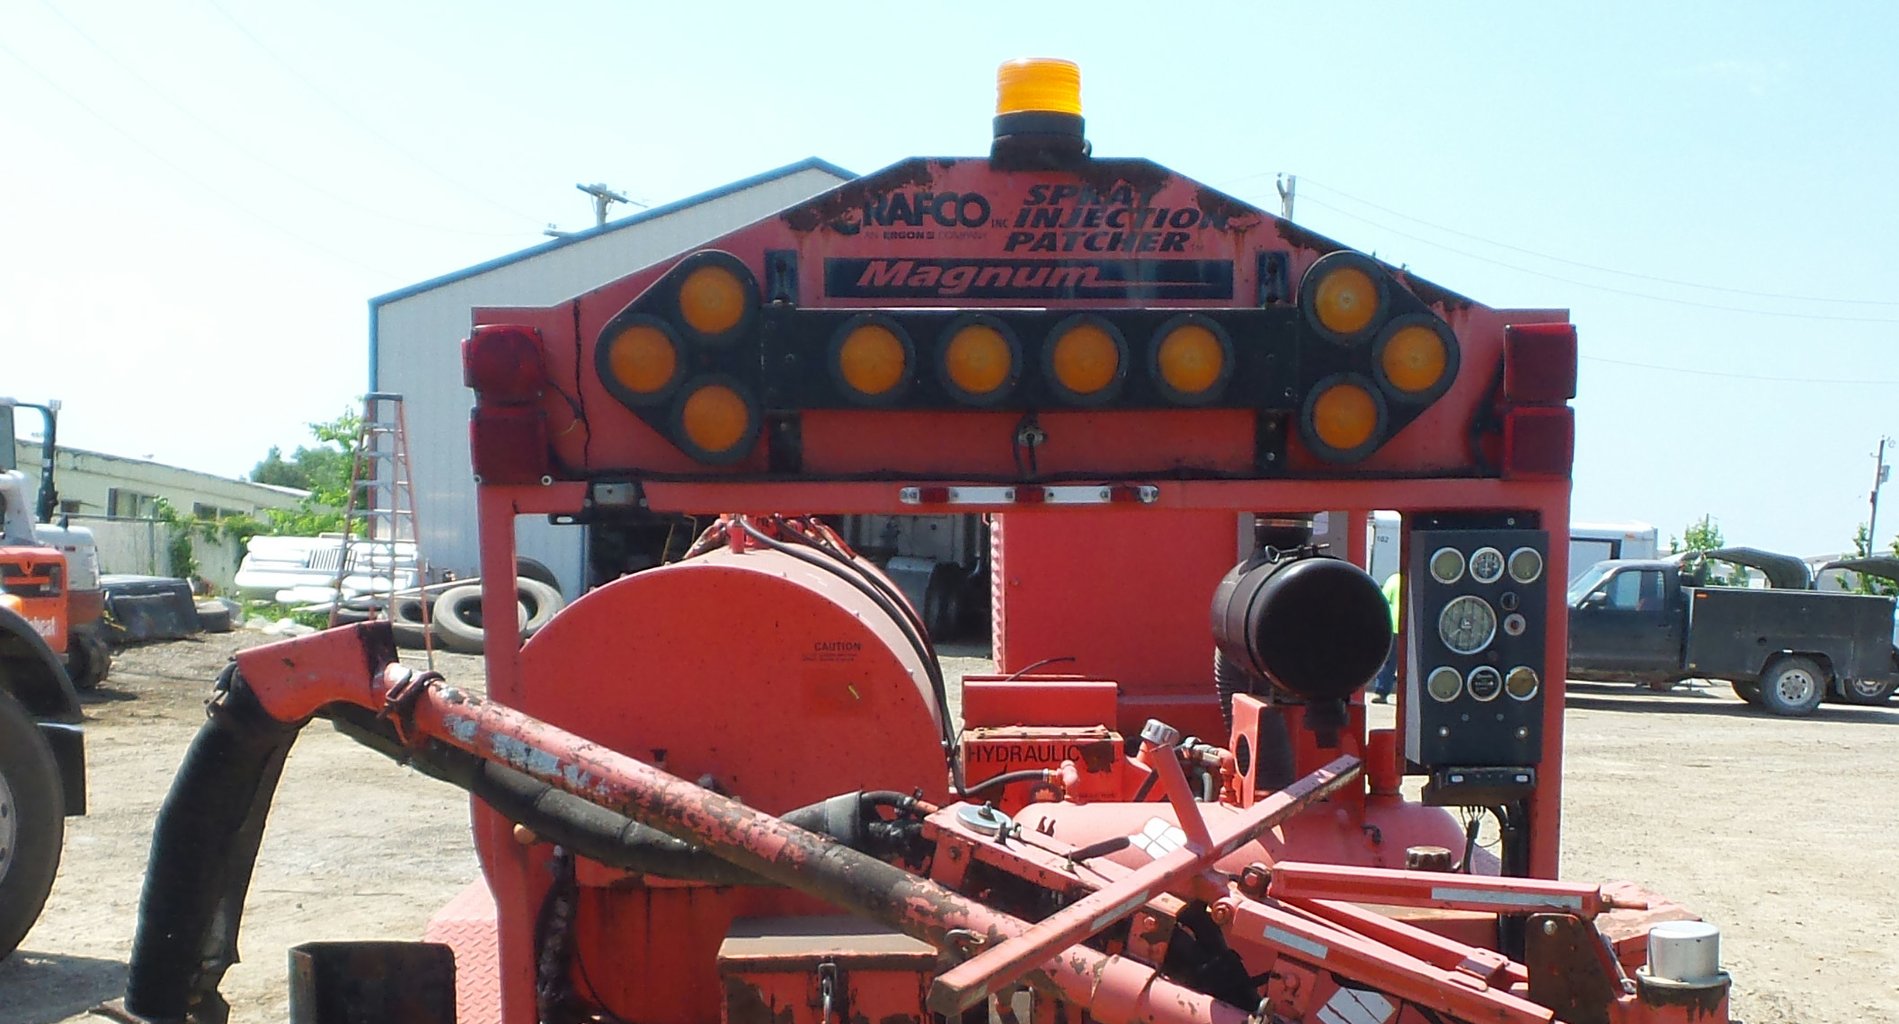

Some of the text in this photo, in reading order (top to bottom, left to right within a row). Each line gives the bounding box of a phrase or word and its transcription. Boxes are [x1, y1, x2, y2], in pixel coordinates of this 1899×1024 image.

[1013, 207, 1228, 230] INJECTION
[883, 231, 924, 240] ERGON
[1003, 231, 1191, 252] PATCHER
[856, 260, 1101, 294] Magnum
[814, 641, 862, 651] CAUTION
[968, 744, 1080, 762] HYDRAULIC
